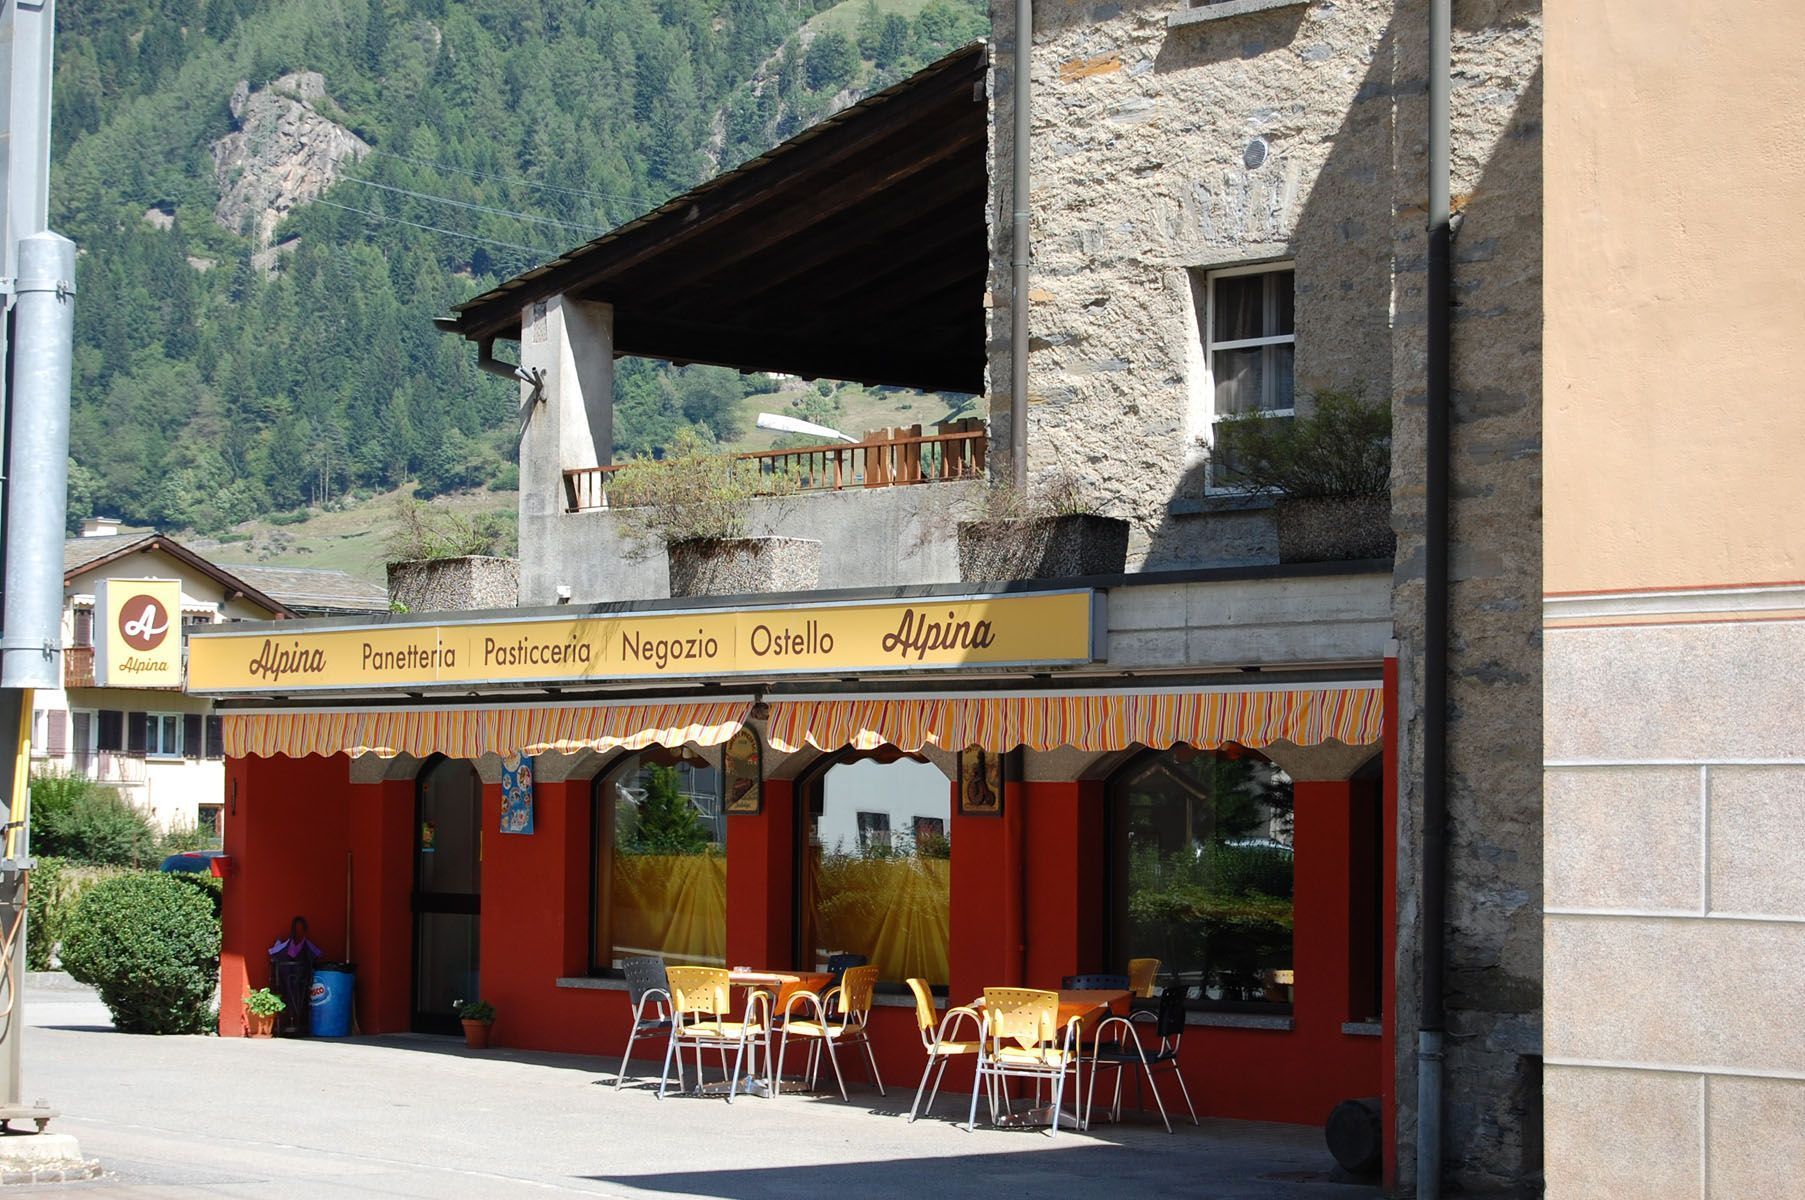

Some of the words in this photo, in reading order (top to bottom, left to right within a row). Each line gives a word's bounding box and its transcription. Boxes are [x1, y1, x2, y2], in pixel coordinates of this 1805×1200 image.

[124, 604, 169, 641] A
[249, 639, 327, 682] Alpina
[362, 640, 456, 671] Panetteria
[484, 633, 591, 666] Pasticceria
[622, 628, 718, 670] Negozio
[750, 620, 834, 657] Ostello
[882, 608, 996, 660] Alpina
[119, 656, 168, 674] Alpina
